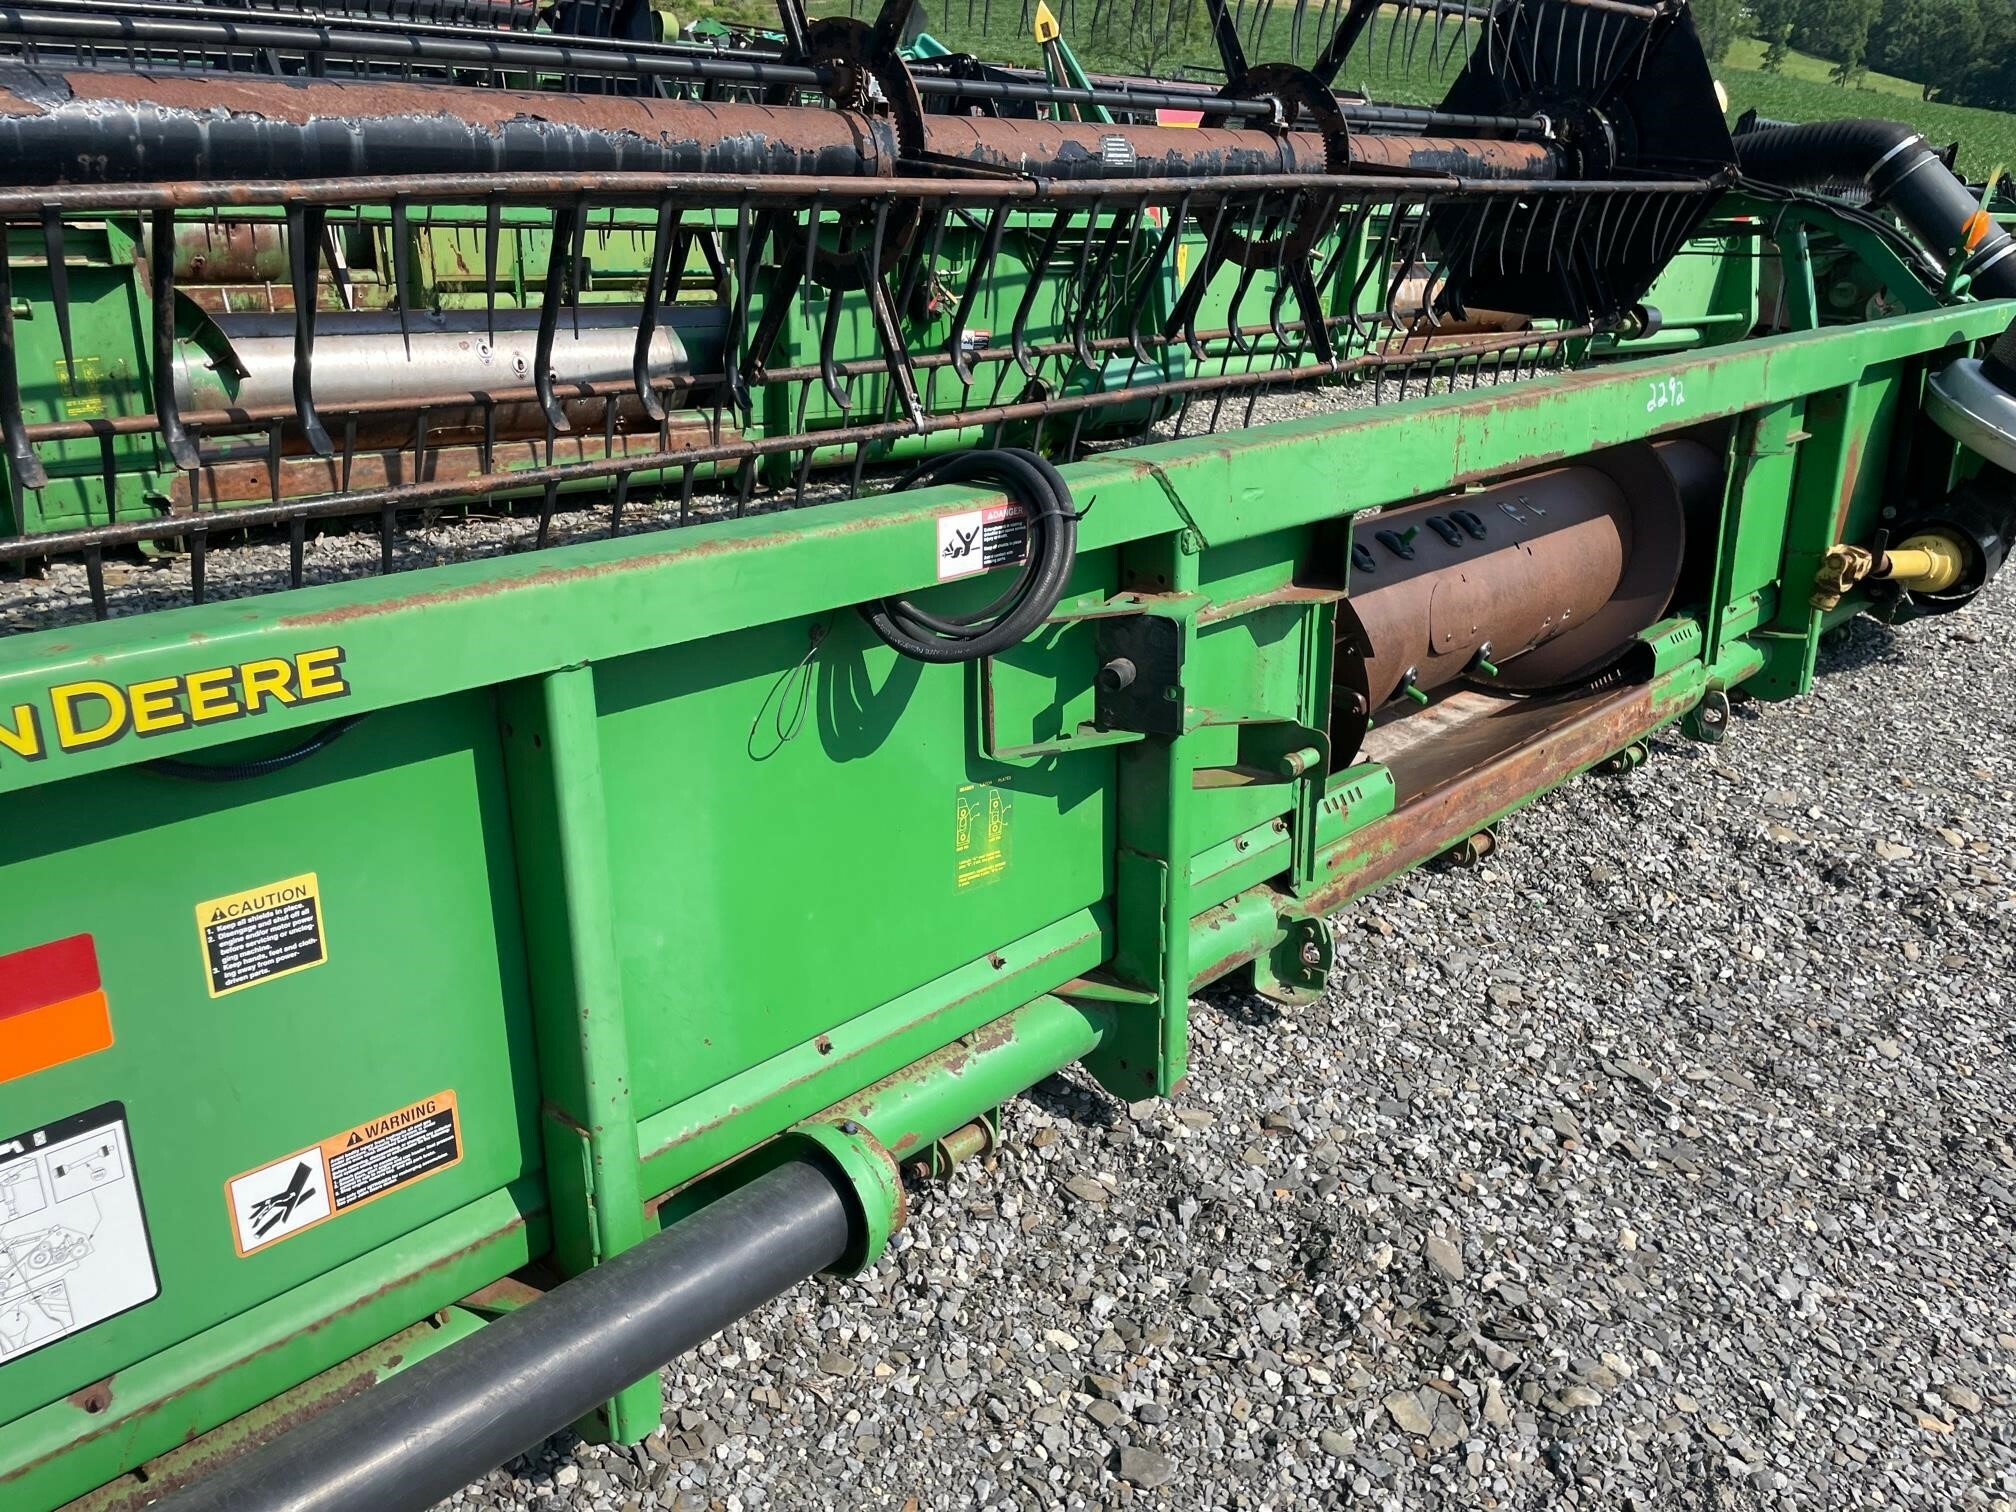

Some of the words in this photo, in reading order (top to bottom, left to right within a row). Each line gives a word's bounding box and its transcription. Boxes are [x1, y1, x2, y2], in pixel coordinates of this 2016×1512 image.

[1647, 377, 1685, 412] 2292
[994, 506, 1023, 519] DANGER
[49, 646, 350, 753] DEERE
[228, 884, 306, 916] CAUTION
[217, 921, 236, 932] Keep
[248, 912, 274, 924] shields
[284, 902, 304, 913] place.
[218, 925, 256, 940] Disengage
[258, 920, 272, 928] and
[273, 915, 289, 924] shut
[301, 908, 309, 916] all
[219, 936, 244, 948] engine
[246, 929, 268, 940] and/or
[270, 923, 291, 932] motor
[292, 916, 313, 928] power
[221, 944, 244, 955] before
[246, 933, 278, 948] servicing
[222, 954, 238, 964] ging
[240, 945, 272, 958] machine.
[223, 961, 242, 971] Keep
[243, 954, 268, 965] hands,
[269, 948, 282, 956] feet
[284, 943, 298, 952] and
[298, 938, 317, 948] cloth-
[224, 970, 236, 978] ing
[237, 964, 256, 974] away
[257, 959, 274, 968] from
[276, 951, 300, 963] power-
[225, 974, 248, 986] driven
[250, 968, 270, 979] parts.
[365, 1101, 436, 1138] WARNING
